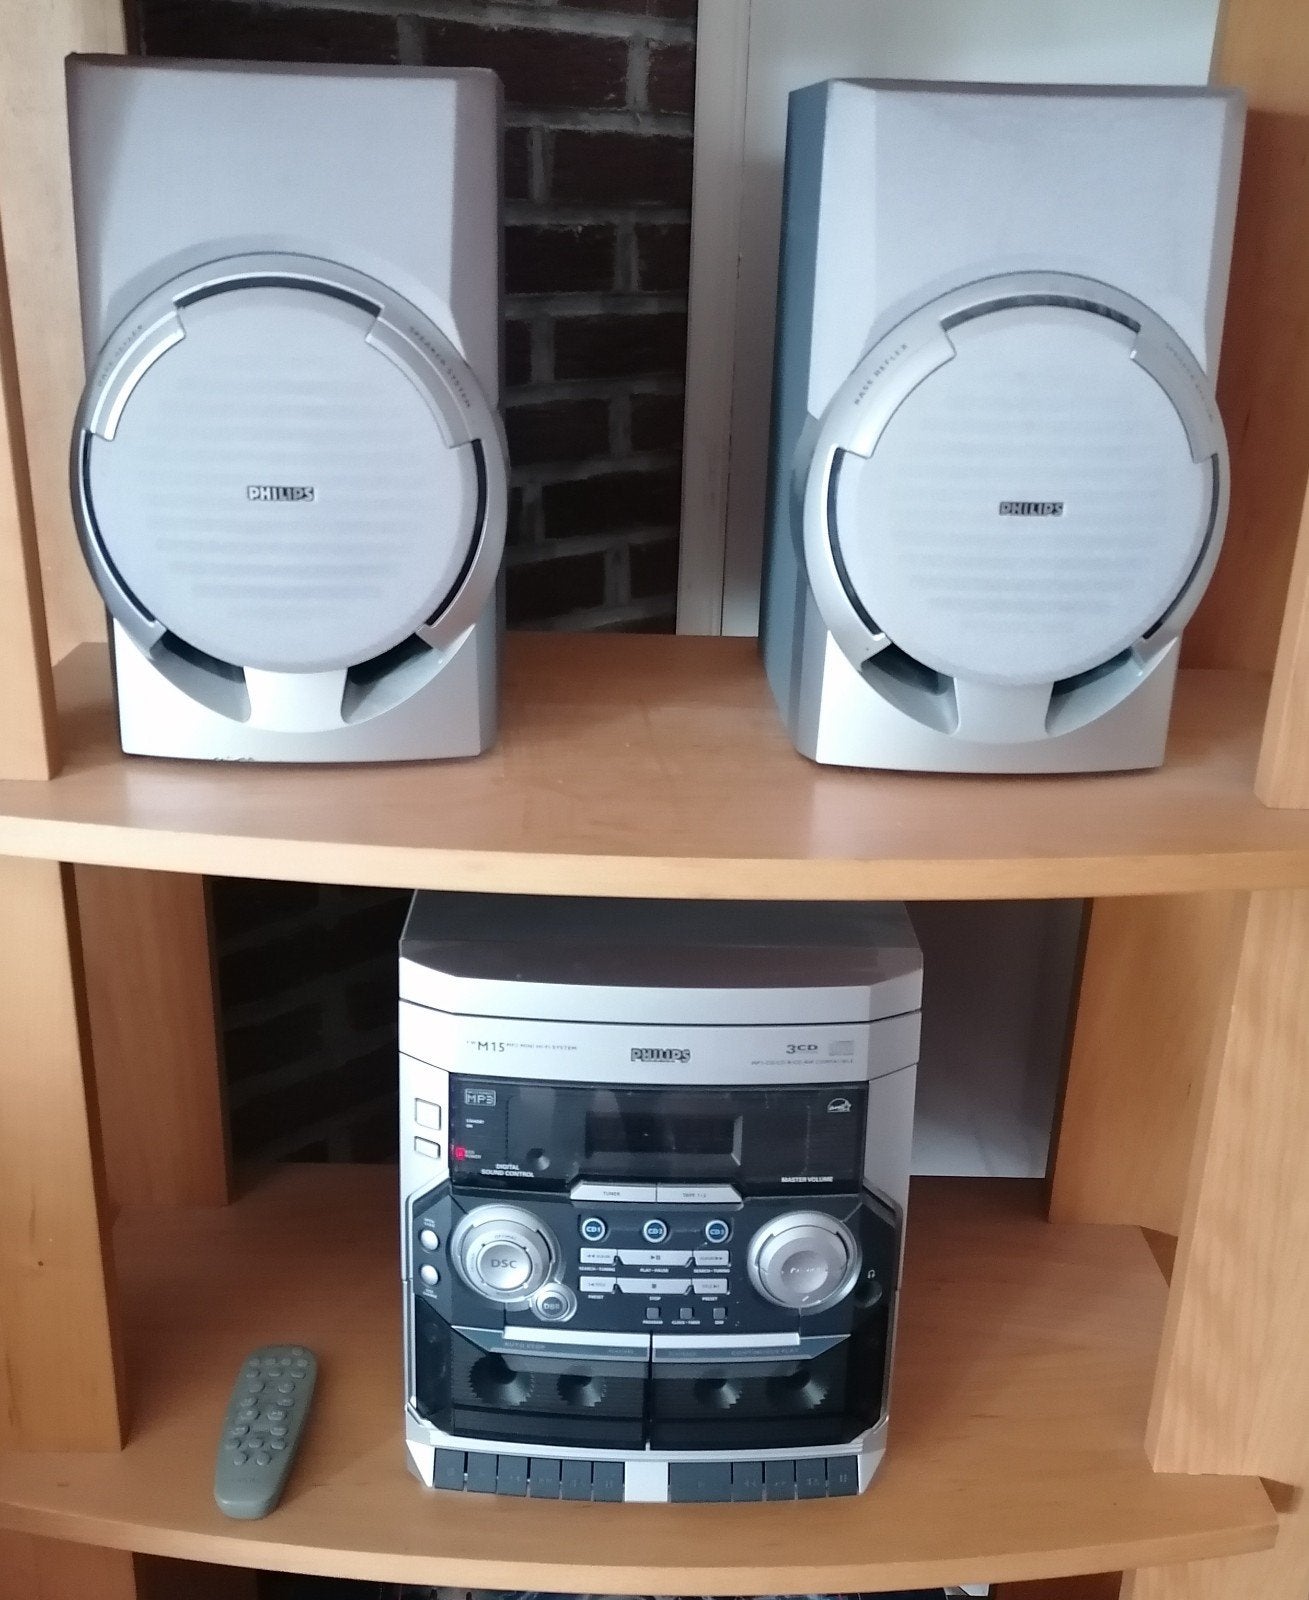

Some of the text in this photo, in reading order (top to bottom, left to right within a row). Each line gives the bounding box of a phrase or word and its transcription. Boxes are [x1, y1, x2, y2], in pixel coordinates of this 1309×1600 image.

[854, 343, 908, 405] BASS REFLEX
[446, 367, 471, 408] SYSTEM
[247, 485, 315, 502] PHILIPS
[999, 501, 1064, 517] PHILIPS
[477, 1040, 506, 1053] M15
[785, 1043, 819, 1054] 3CD
[630, 1047, 691, 1063] PHILIPS
[467, 1094, 495, 1104] MP3
[480, 1168, 535, 1178] SOUND CONTROL
[495, 1163, 520, 1171] DIGITAL
[585, 1225, 602, 1234] CD1
[490, 1258, 518, 1269] DSC
